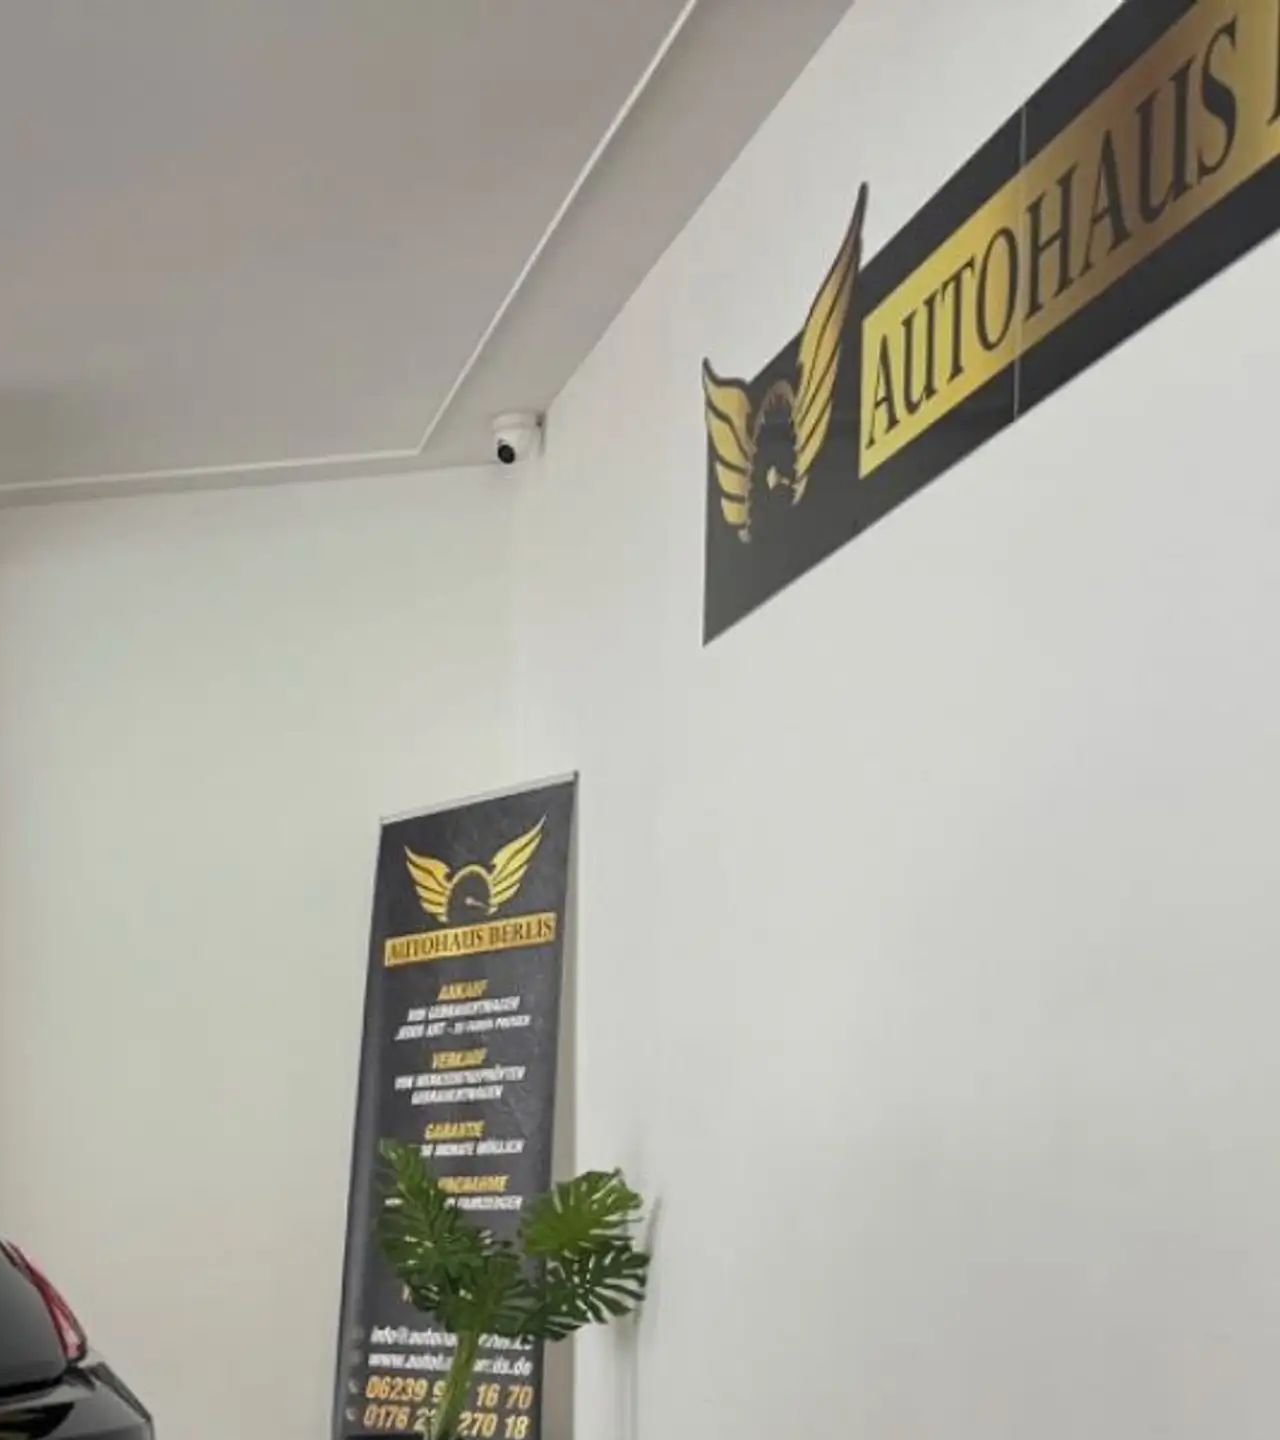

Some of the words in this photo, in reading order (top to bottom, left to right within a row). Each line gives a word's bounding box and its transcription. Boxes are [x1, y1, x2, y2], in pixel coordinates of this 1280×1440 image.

[865, 16, 1238, 449] AUTOHAUS
[388, 926, 483, 961] AUTOHAUS
[488, 917, 553, 946] BERLIS
[365, 1375, 428, 1402] 06239
[476, 1382, 502, 1409] 16
[504, 1384, 535, 1411] 70
[362, 1403, 411, 1430] 0176
[457, 1411, 498, 1439] 270
